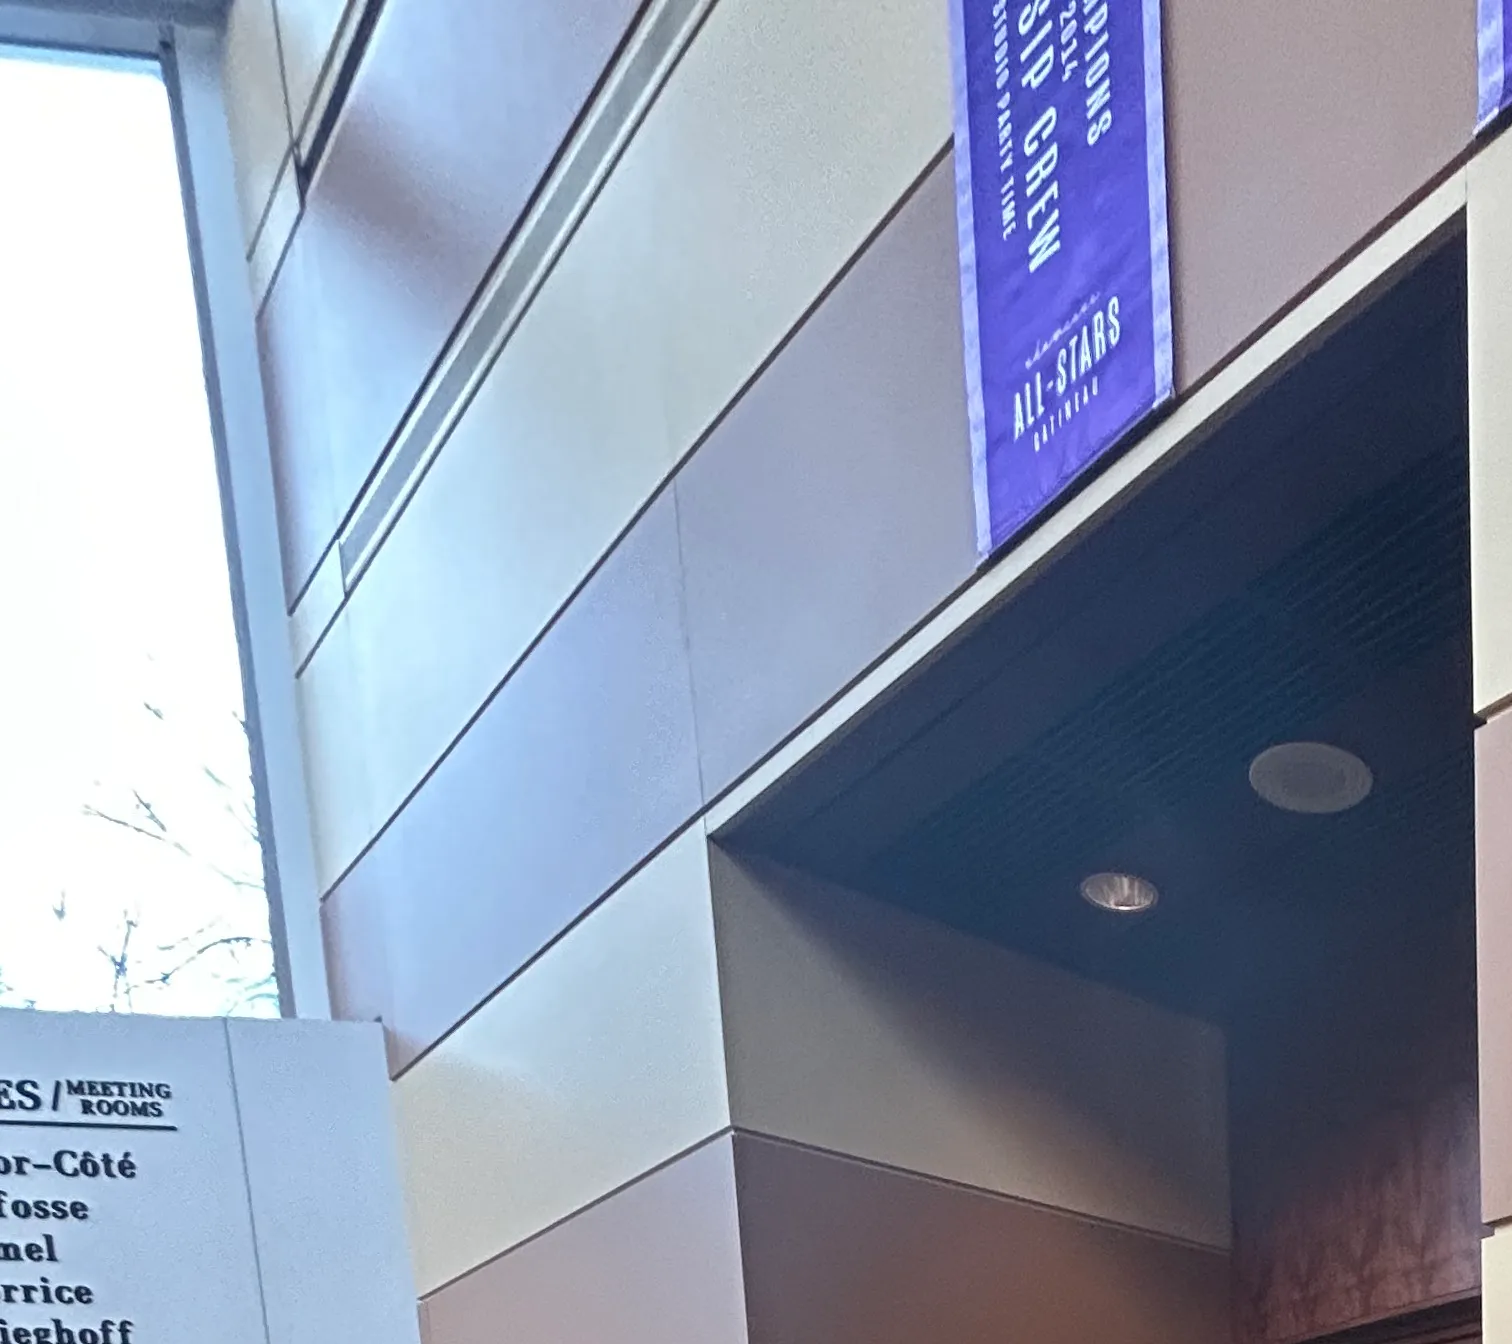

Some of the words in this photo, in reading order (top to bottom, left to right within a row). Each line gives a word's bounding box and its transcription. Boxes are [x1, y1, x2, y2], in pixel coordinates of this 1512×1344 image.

[997, 92, 1014, 173] PARTY
[1000, 176, 1016, 241] TIME
[1024, 106, 1060, 273] CREW
[1013, 296, 1120, 443] ALL-STARS
[66, 1079, 172, 1099] MEETING
[80, 1098, 163, 1117] ROOMS
